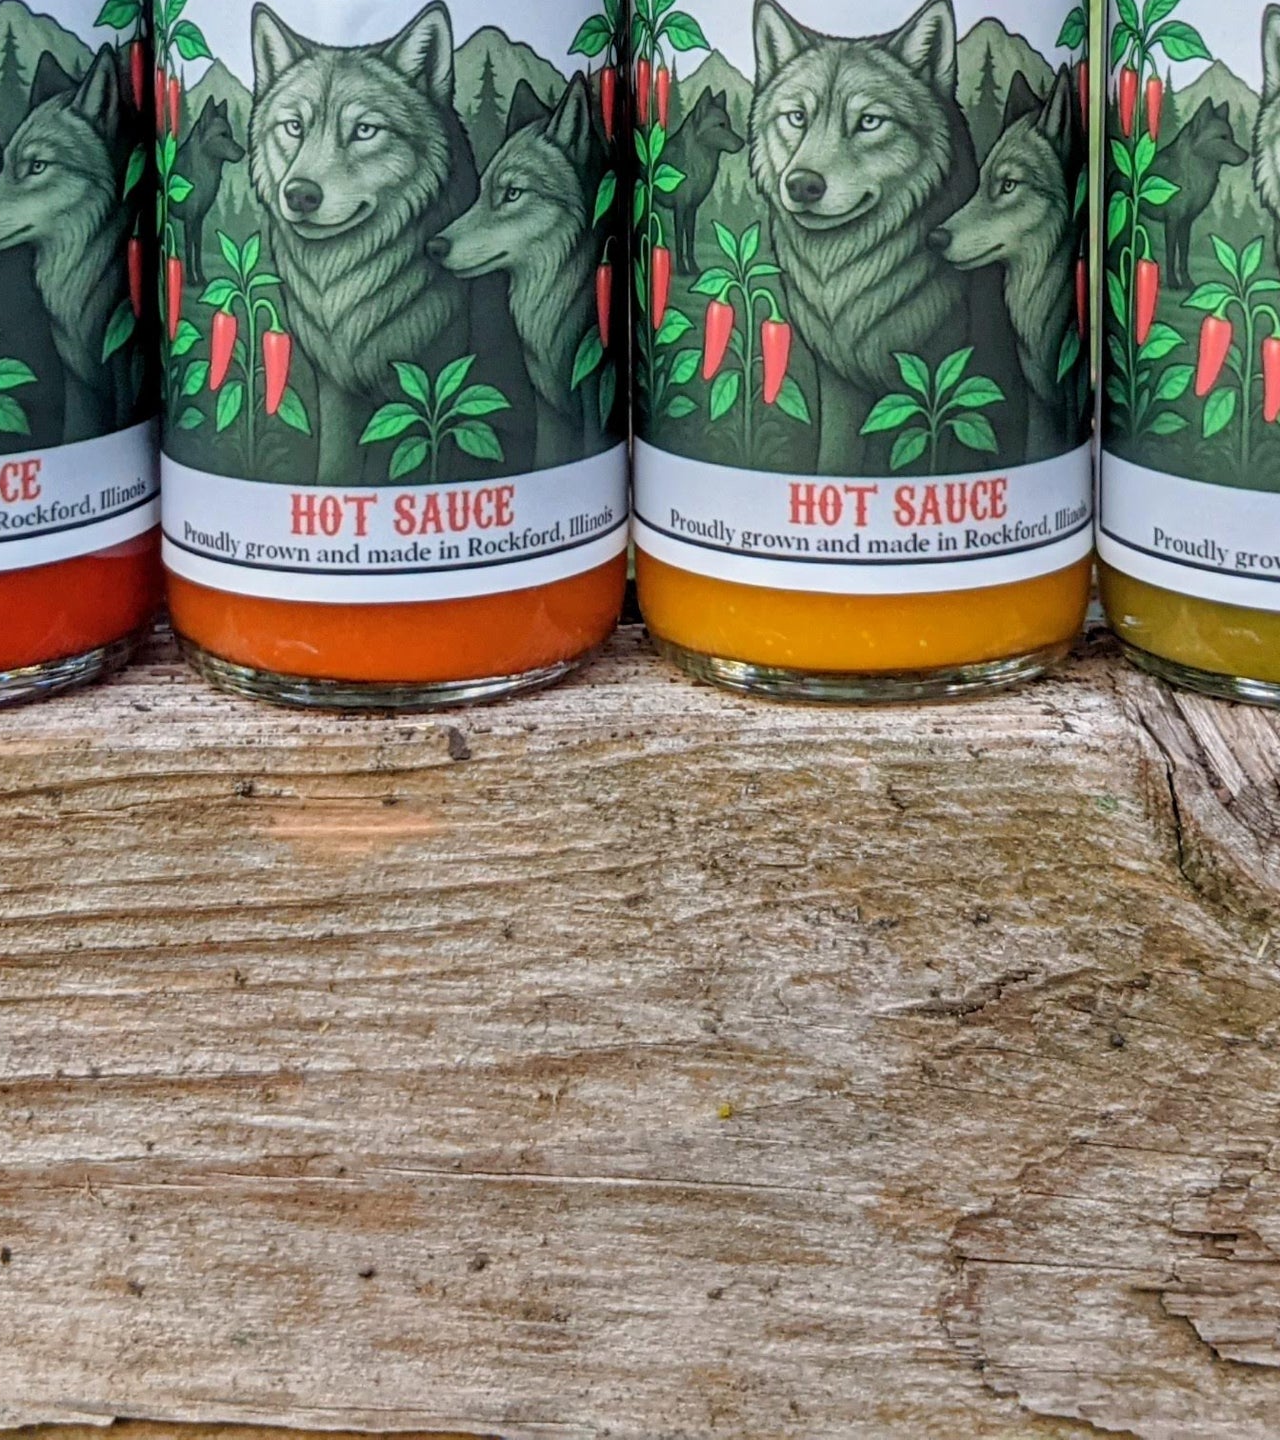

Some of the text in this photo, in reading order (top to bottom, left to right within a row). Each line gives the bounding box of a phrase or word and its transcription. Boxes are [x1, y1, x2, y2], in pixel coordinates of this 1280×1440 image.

[100, 477, 146, 510] Illinois
[291, 485, 515, 537] HOT SAUCE
[788, 477, 1007, 527] HOT SAUCE
[183, 505, 613, 564] Proudly grown and made in Rockford, Illinois
[670, 508, 735, 546] Proudly
[740, 528, 810, 553] grown
[816, 532, 859, 555] and
[868, 532, 930, 554] made
[937, 530, 958, 552] in
[965, 514, 1051, 550] Rockford,
[1153, 526, 1229, 566] Proudly
